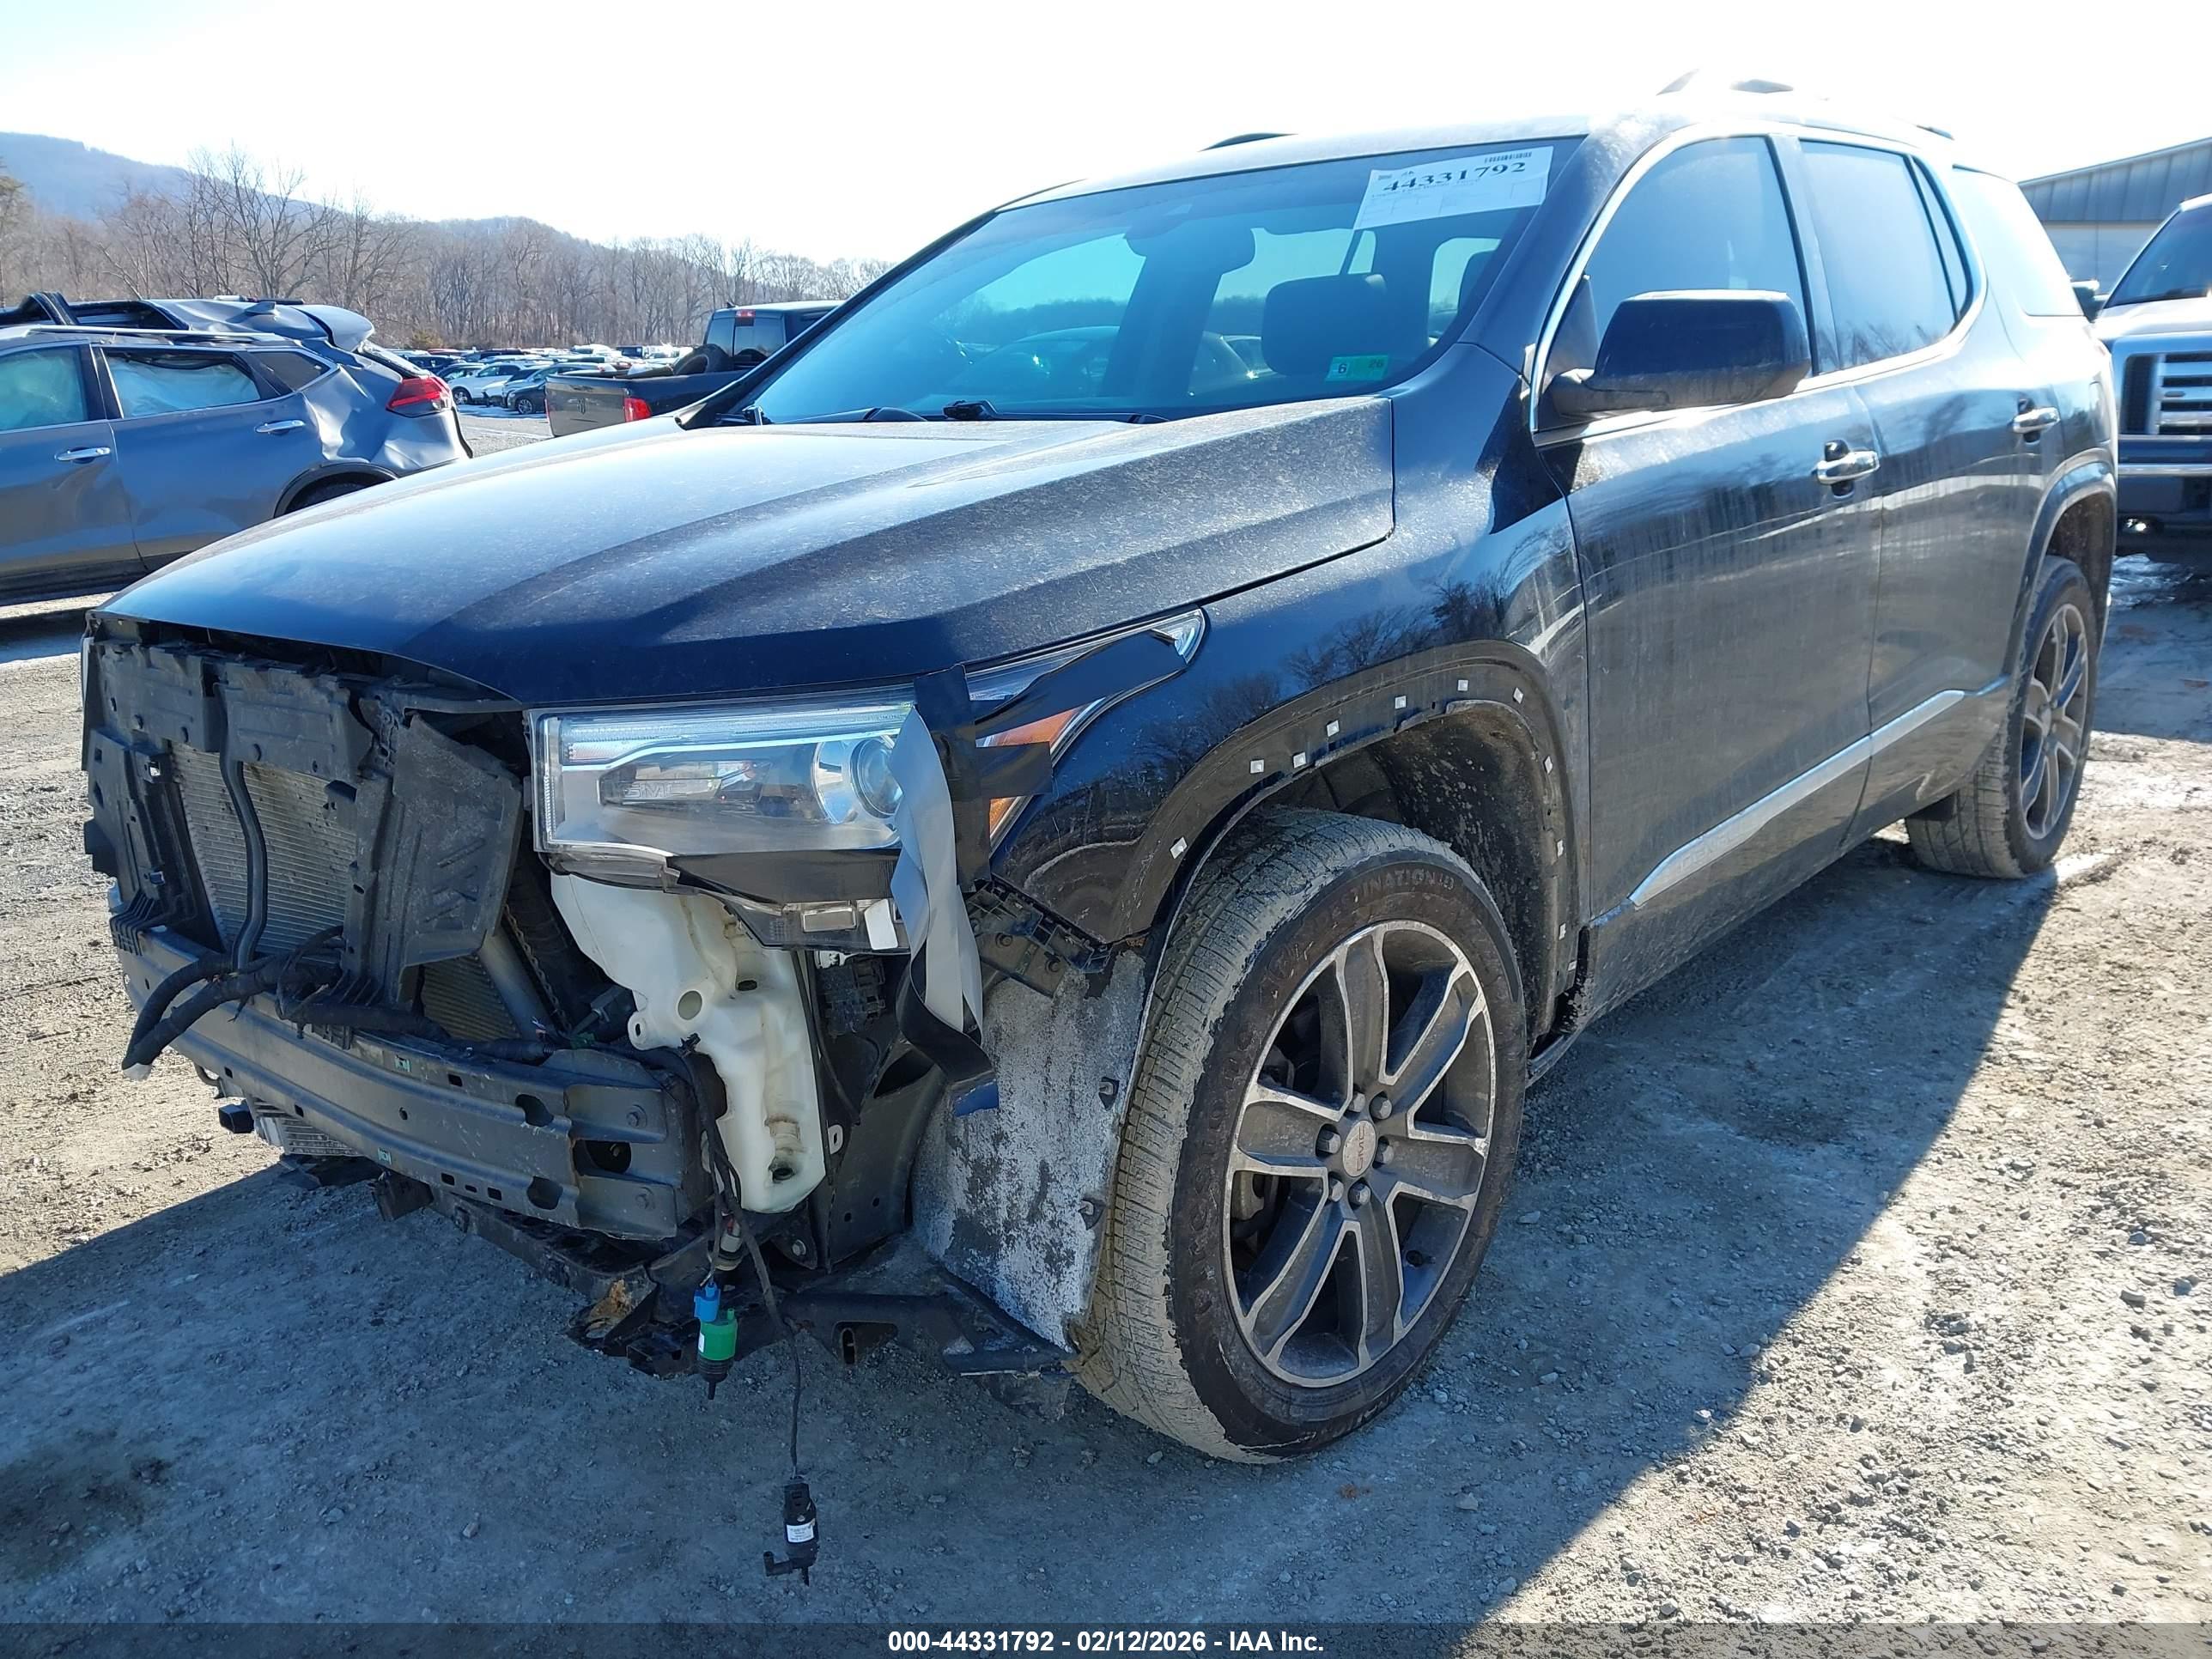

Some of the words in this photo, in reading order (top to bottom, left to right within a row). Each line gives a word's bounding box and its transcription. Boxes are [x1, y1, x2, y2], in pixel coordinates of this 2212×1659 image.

[1382, 161, 1526, 191] 44331792
[1338, 363, 1347, 374] 6
[1356, 1126, 1365, 1172] GMC
